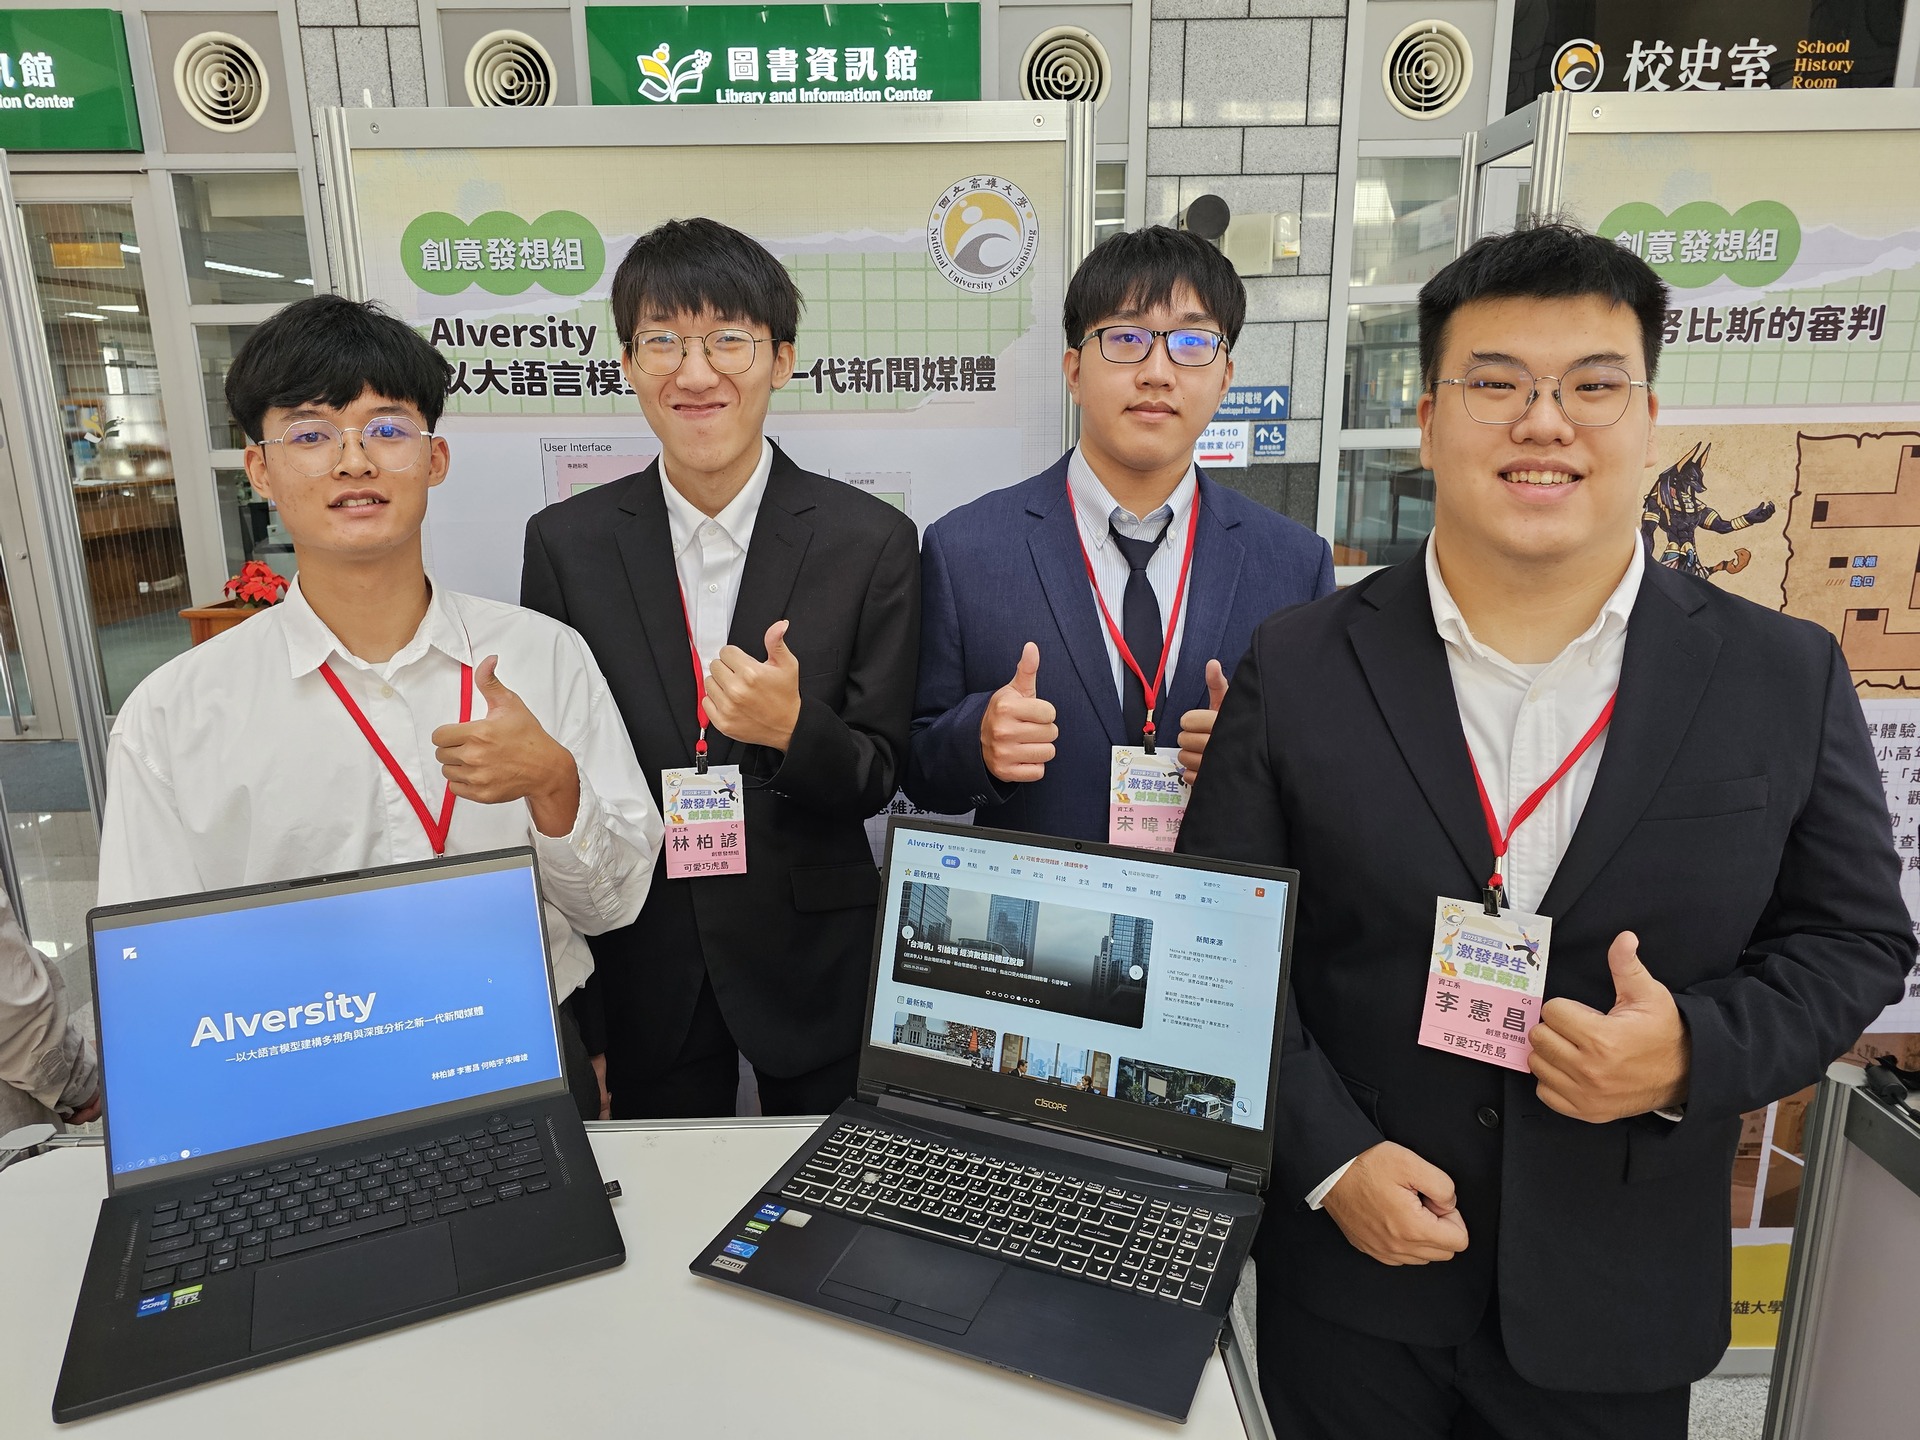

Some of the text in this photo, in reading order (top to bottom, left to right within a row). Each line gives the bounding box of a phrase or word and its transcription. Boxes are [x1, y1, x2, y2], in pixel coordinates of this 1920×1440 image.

[1797, 40, 1850, 54] School
[727, 46, 918, 83] 圖書資訊館
[1623, 38, 1778, 92] 校史室
[1794, 58, 1854, 73] History
[1792, 76, 1837, 88] Room
[23, 93, 75, 109] Center
[715, 86, 933, 104] Library and Information Center
[419, 237, 585, 271] 創意發想組
[1614, 228, 1778, 264] 創意發想組
[929, 227, 1037, 291] National University of Kaohsiung
[430, 316, 597, 356] AIversity
[1201, 428, 1239, 437] 01-610
[544, 443, 612, 452] User Interface
[1850, 576, 1875, 587] 路口
[1127, 777, 1179, 794] 激發學生
[680, 797, 731, 810] 激發學生
[672, 832, 738, 852] 林柏諺
[907, 838, 945, 852] AIversity
[683, 861, 729, 873] 可愛巧虎島
[1456, 942, 1528, 975] 激發學生
[1438, 977, 1461, 990] 資工系
[1463, 962, 1530, 991] 創意競賽
[1521, 997, 1532, 1006] C4
[191, 991, 377, 1048] AIversity
[1435, 990, 1526, 1033] 李憲昌
[1485, 1027, 1527, 1045] 創意發想組
[1443, 1032, 1508, 1060] 可愛巧虎島
[715, 1257, 744, 1270] HDMI
[174, 1294, 199, 1307] RTX
[1732, 1300, 1784, 1315] 雄大學
